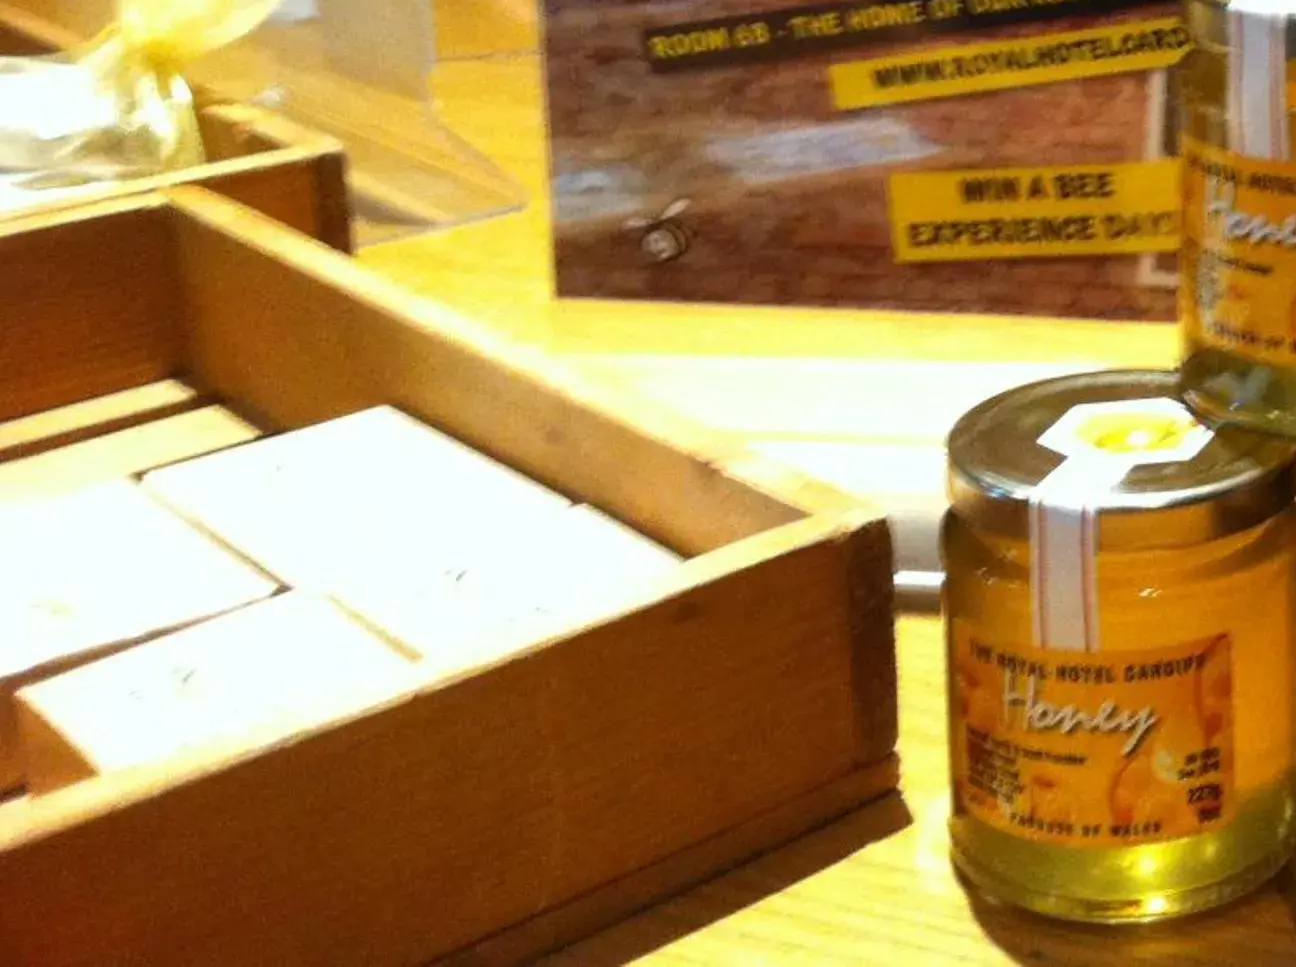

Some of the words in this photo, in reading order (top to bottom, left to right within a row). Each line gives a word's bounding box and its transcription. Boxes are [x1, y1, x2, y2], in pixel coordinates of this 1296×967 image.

[649, 27, 729, 59] ROOM
[787, 11, 843, 39] THE
[847, 0, 927, 31] HOME
[961, 177, 1020, 203] WIN
[1026, 174, 1049, 201] A
[1052, 172, 1116, 200] BEE
[908, 215, 1098, 248] EXPERIENCE
[1003, 670, 1160, 758] Honey
